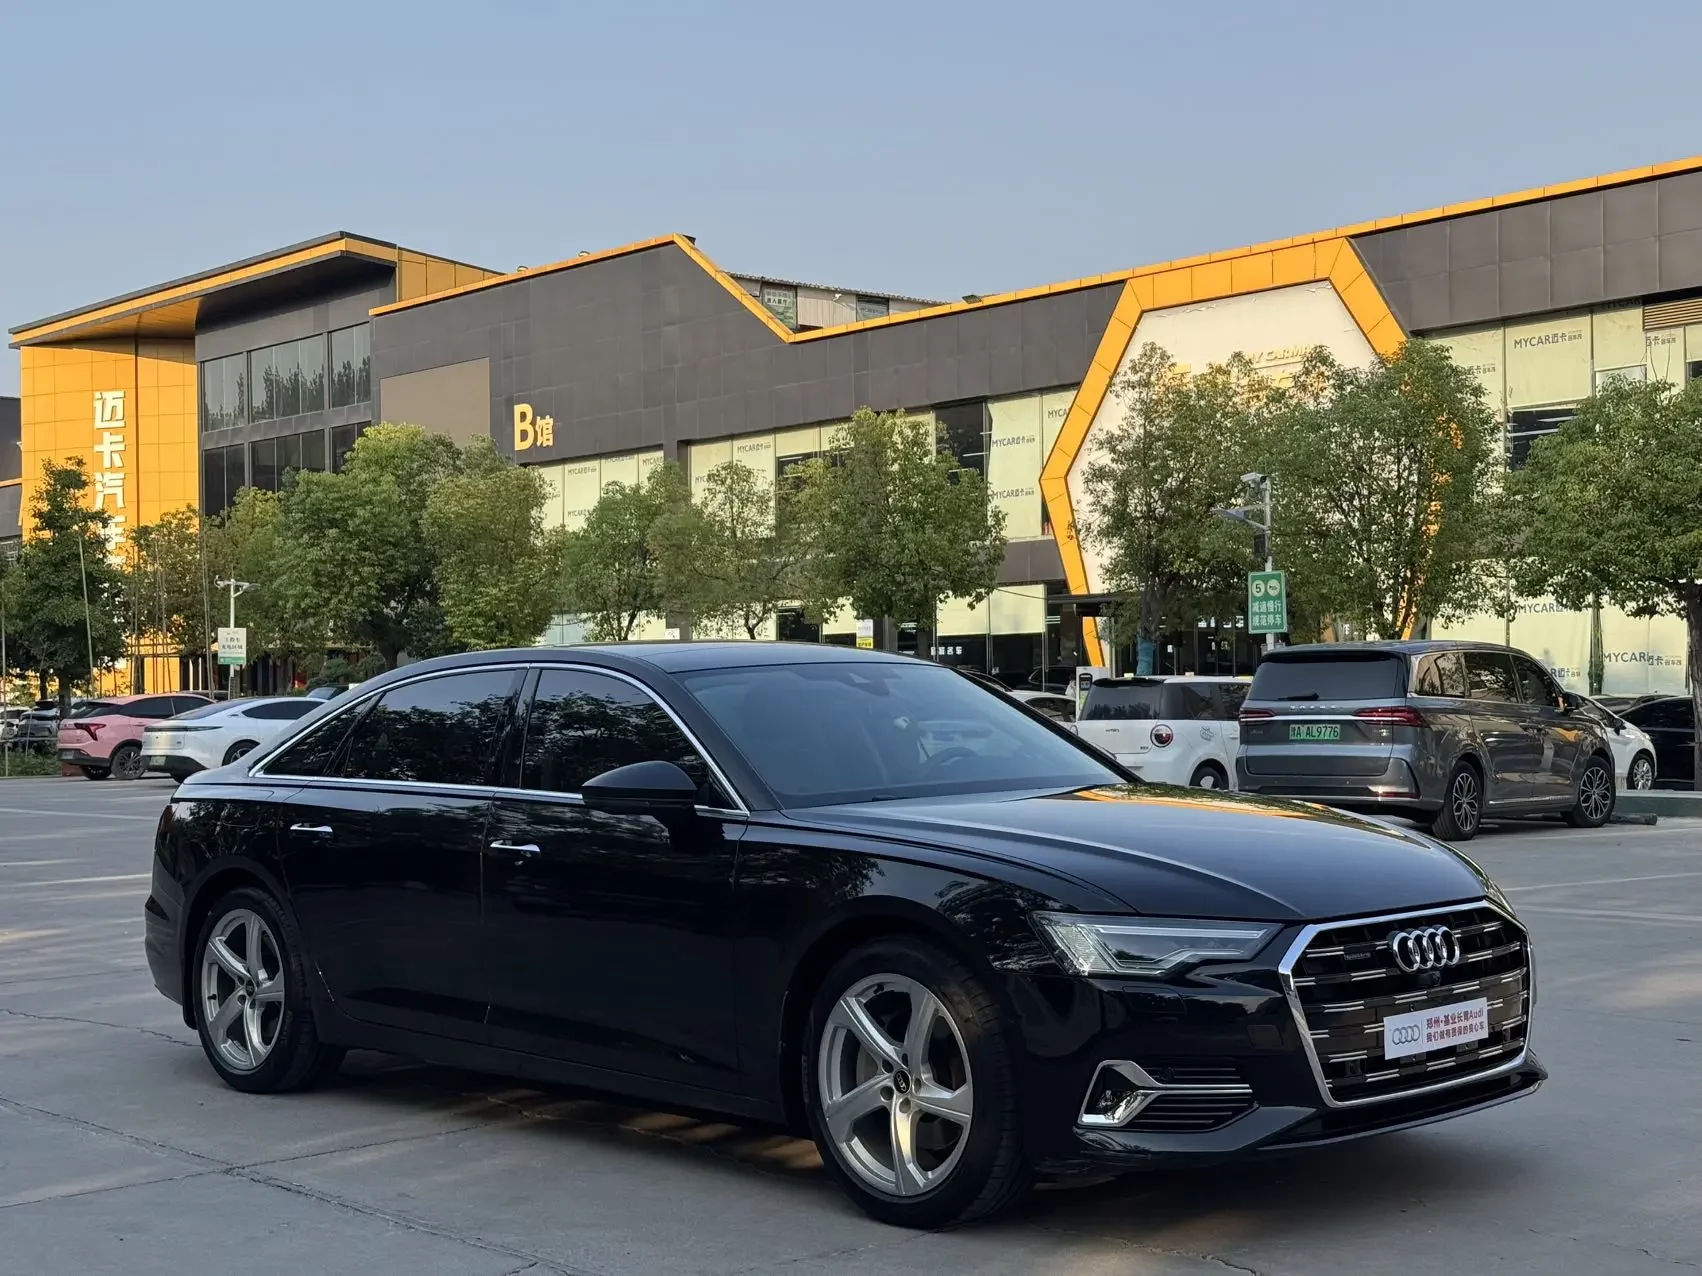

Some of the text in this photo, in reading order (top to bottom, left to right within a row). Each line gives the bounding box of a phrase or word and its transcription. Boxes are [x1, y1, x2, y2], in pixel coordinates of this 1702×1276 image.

[1047, 408, 1070, 419] MYCA
[513, 403, 554, 451] B馆
[1255, 583, 1262, 594] 5
[1252, 600, 1282, 613] 减速慢行
[1252, 614, 1282, 627] 规范停车
[1305, 726, 1339, 738] AL9776
